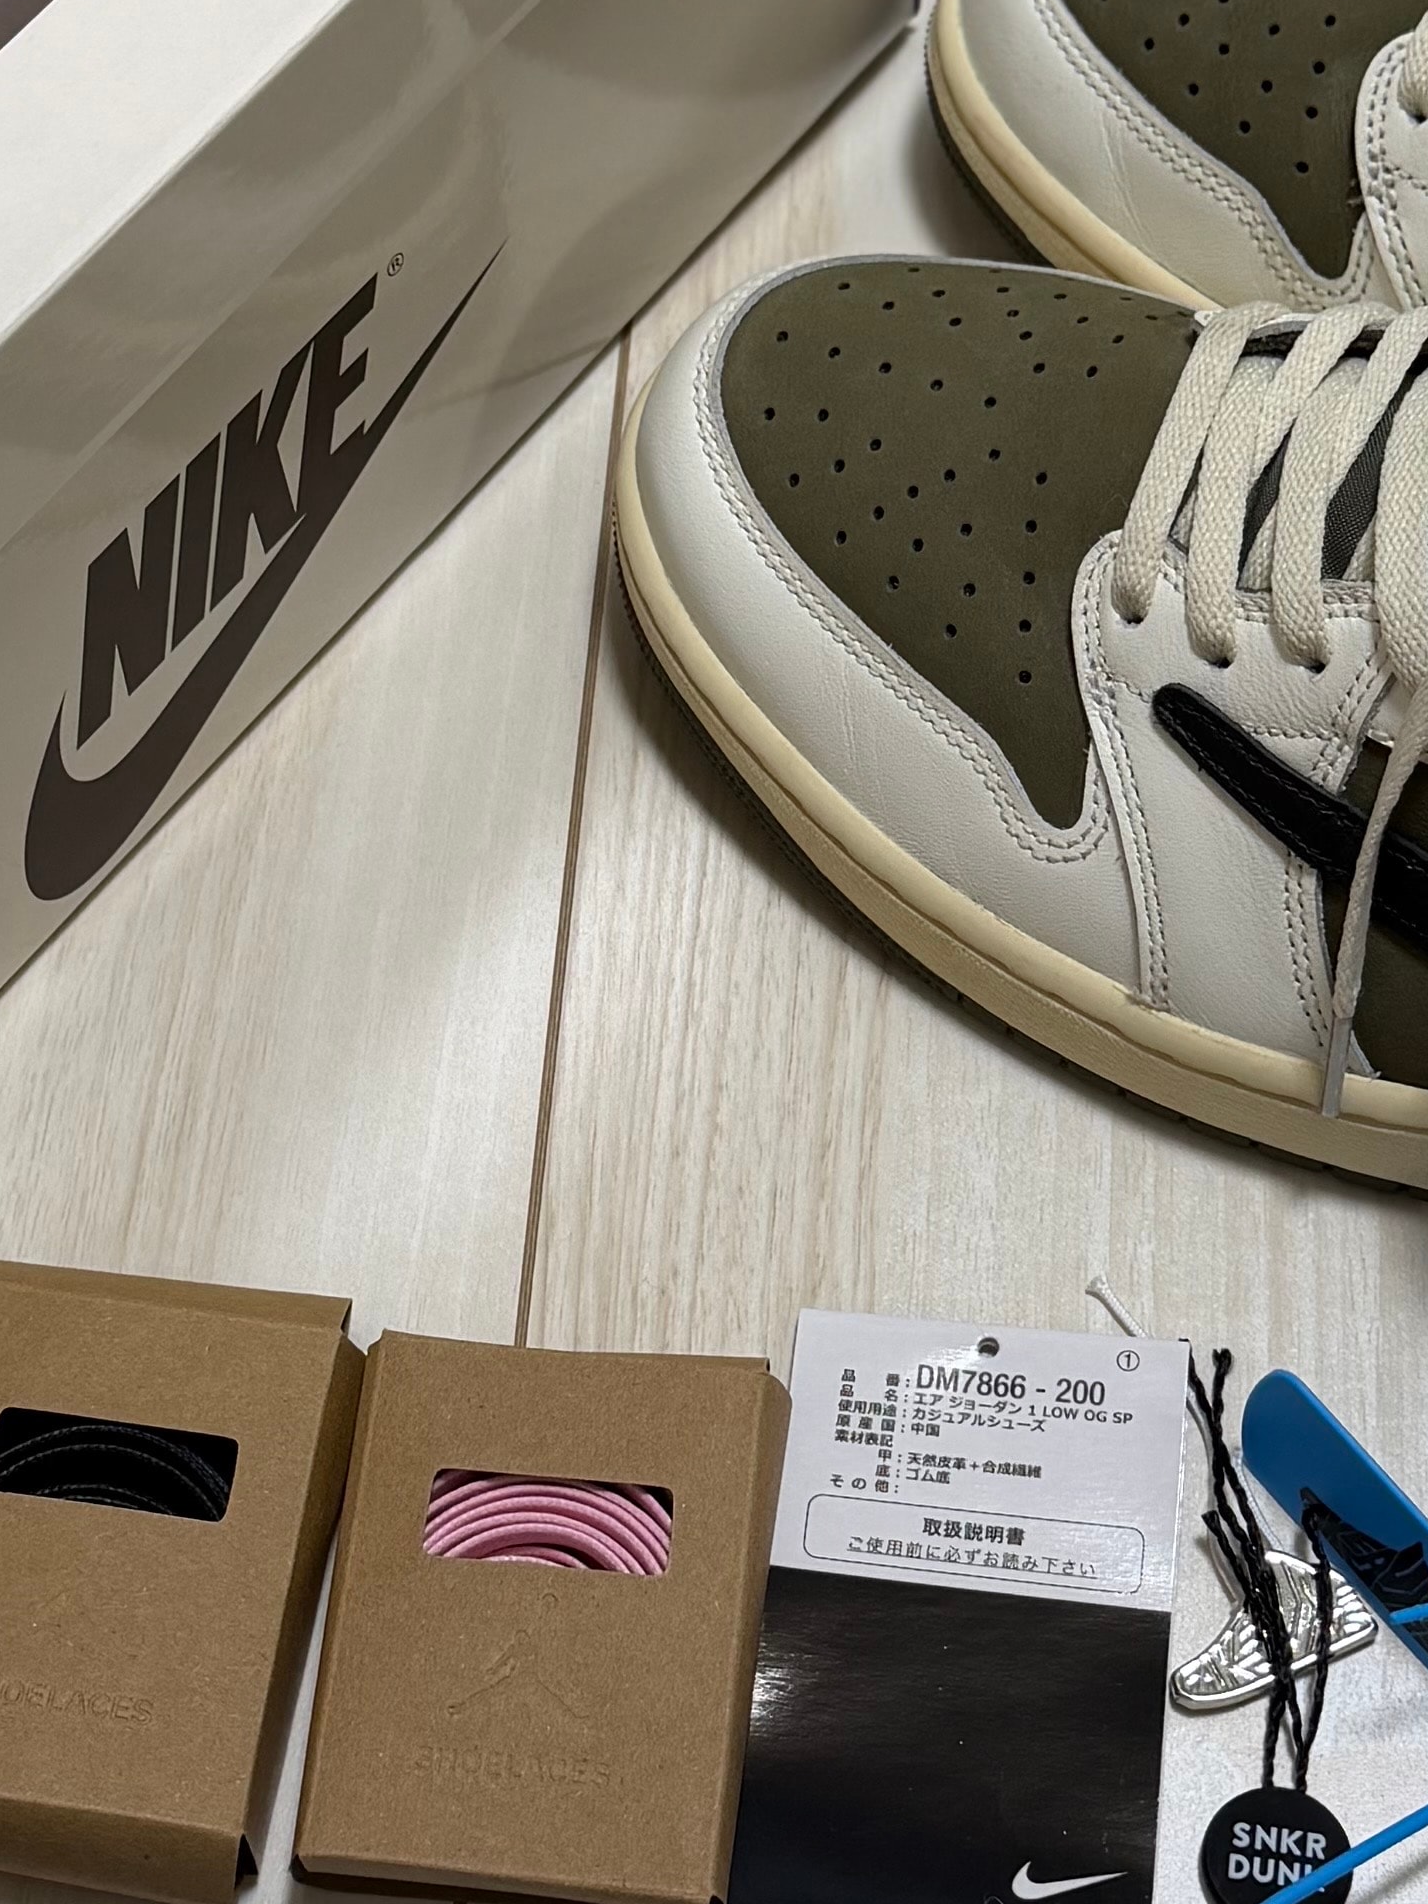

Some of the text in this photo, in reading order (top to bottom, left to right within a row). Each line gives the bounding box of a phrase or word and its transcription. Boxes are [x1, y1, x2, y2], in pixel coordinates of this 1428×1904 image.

[76, 271, 378, 751] NIKE
[916, 1363, 1027, 1400] DM7866
[1055, 1377, 1106, 1406] 200
[1042, 1405, 1079, 1420] LOW
[1084, 1409, 1107, 1423] OG
[1112, 1412, 1133, 1424] SP
[922, 1517, 1026, 1546] 取扱説明書
[847, 1535, 1097, 1577] ご使用前に必ずお読み下さい
[1231, 1821, 1327, 1860] SNKR
